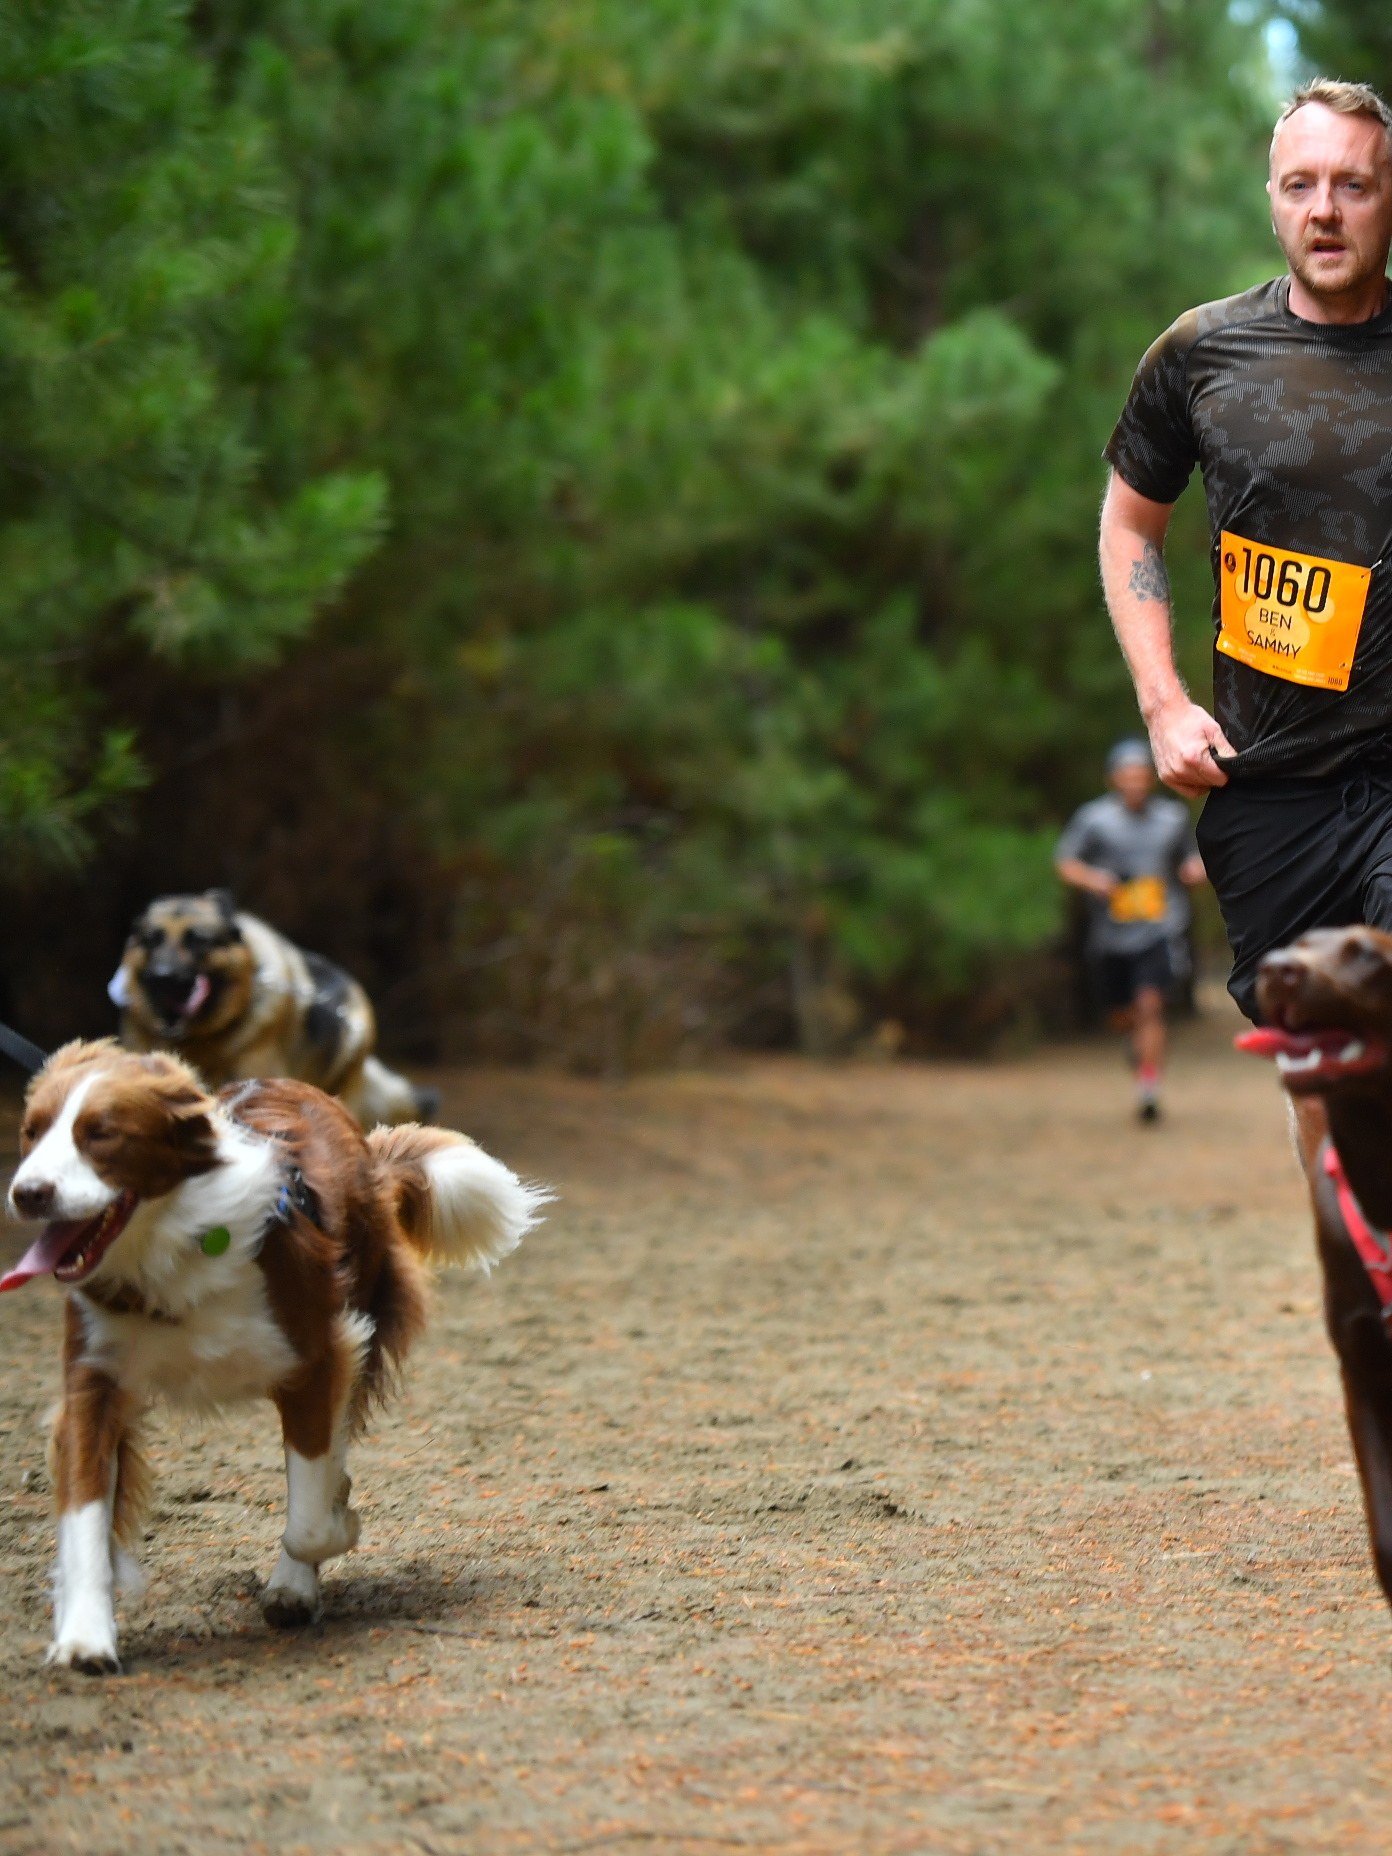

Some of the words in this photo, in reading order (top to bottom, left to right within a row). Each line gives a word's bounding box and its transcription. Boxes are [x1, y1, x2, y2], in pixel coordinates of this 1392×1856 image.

[1242, 547, 1332, 613] 1060
[1259, 607, 1292, 630] BEN
[1247, 630, 1302, 660] SAMMY
